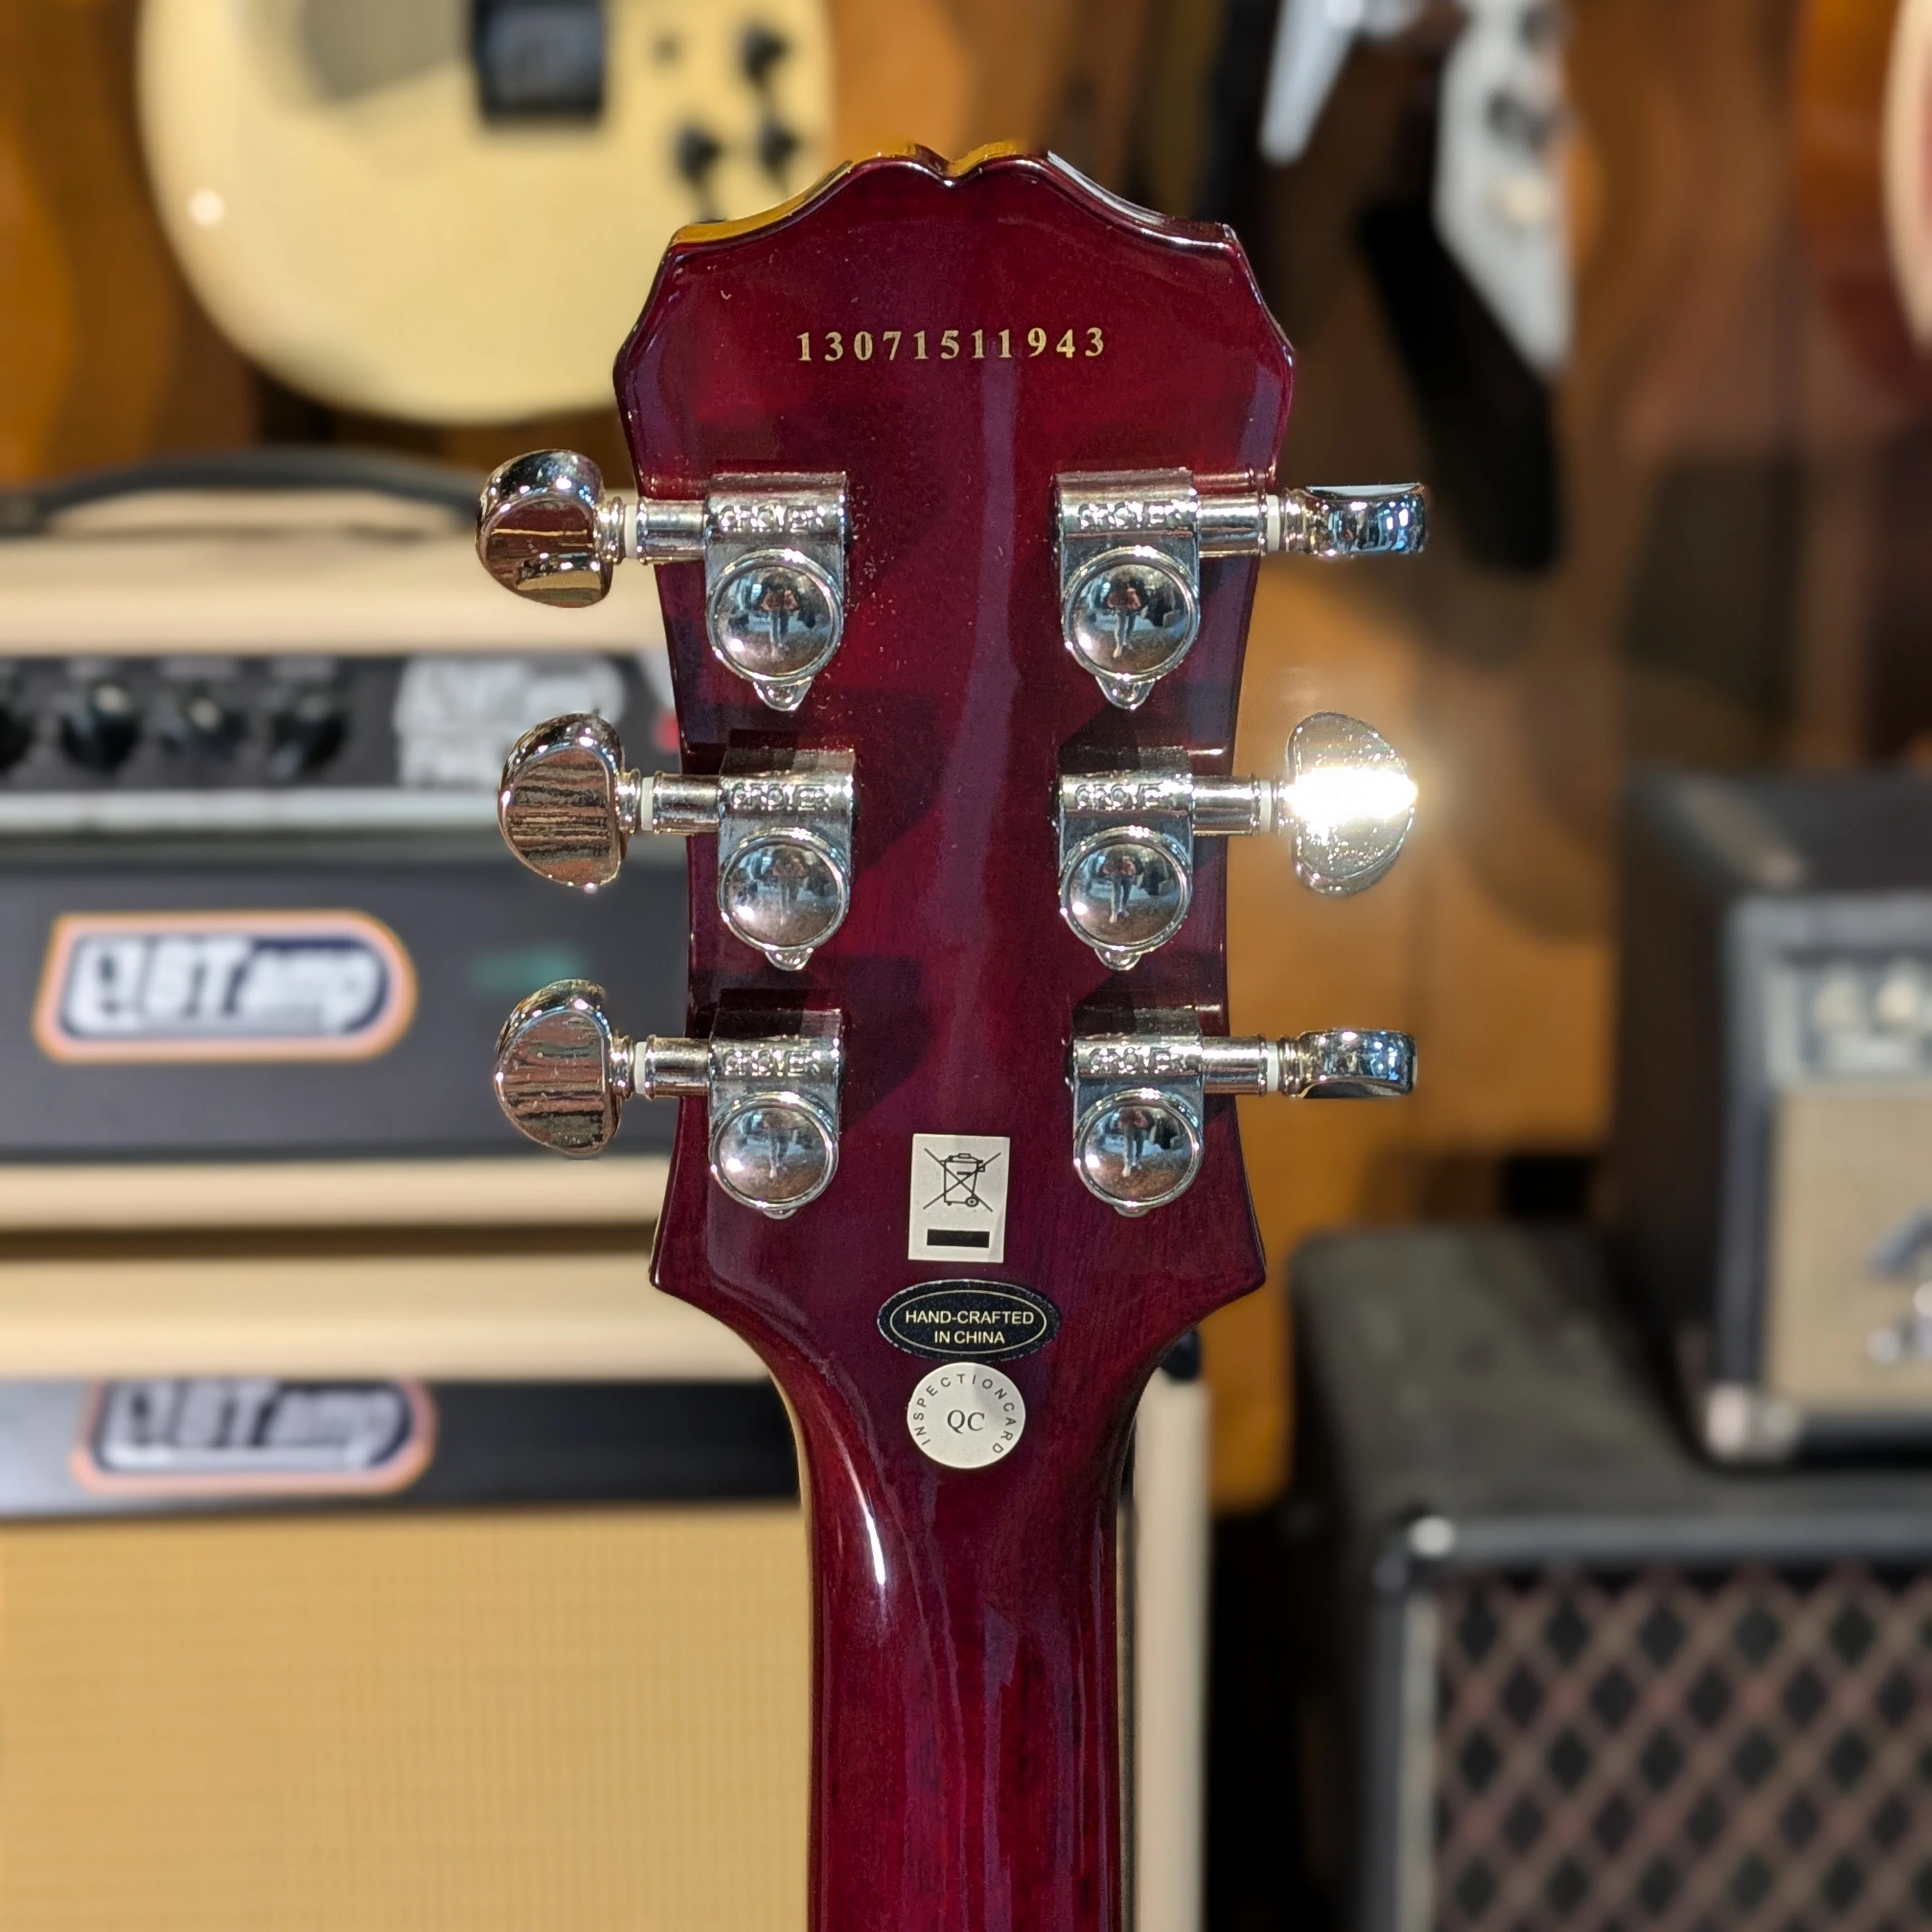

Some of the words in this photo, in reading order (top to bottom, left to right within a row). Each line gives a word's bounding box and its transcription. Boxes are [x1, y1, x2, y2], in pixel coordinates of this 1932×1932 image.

[797, 327, 1104, 362] 13071511943
[905, 1310, 1034, 1325] HAND-CRAFTED
[934, 1331, 950, 1344] IN
[953, 1330, 1005, 1344] CHINA
[947, 1409, 985, 1434] QC
